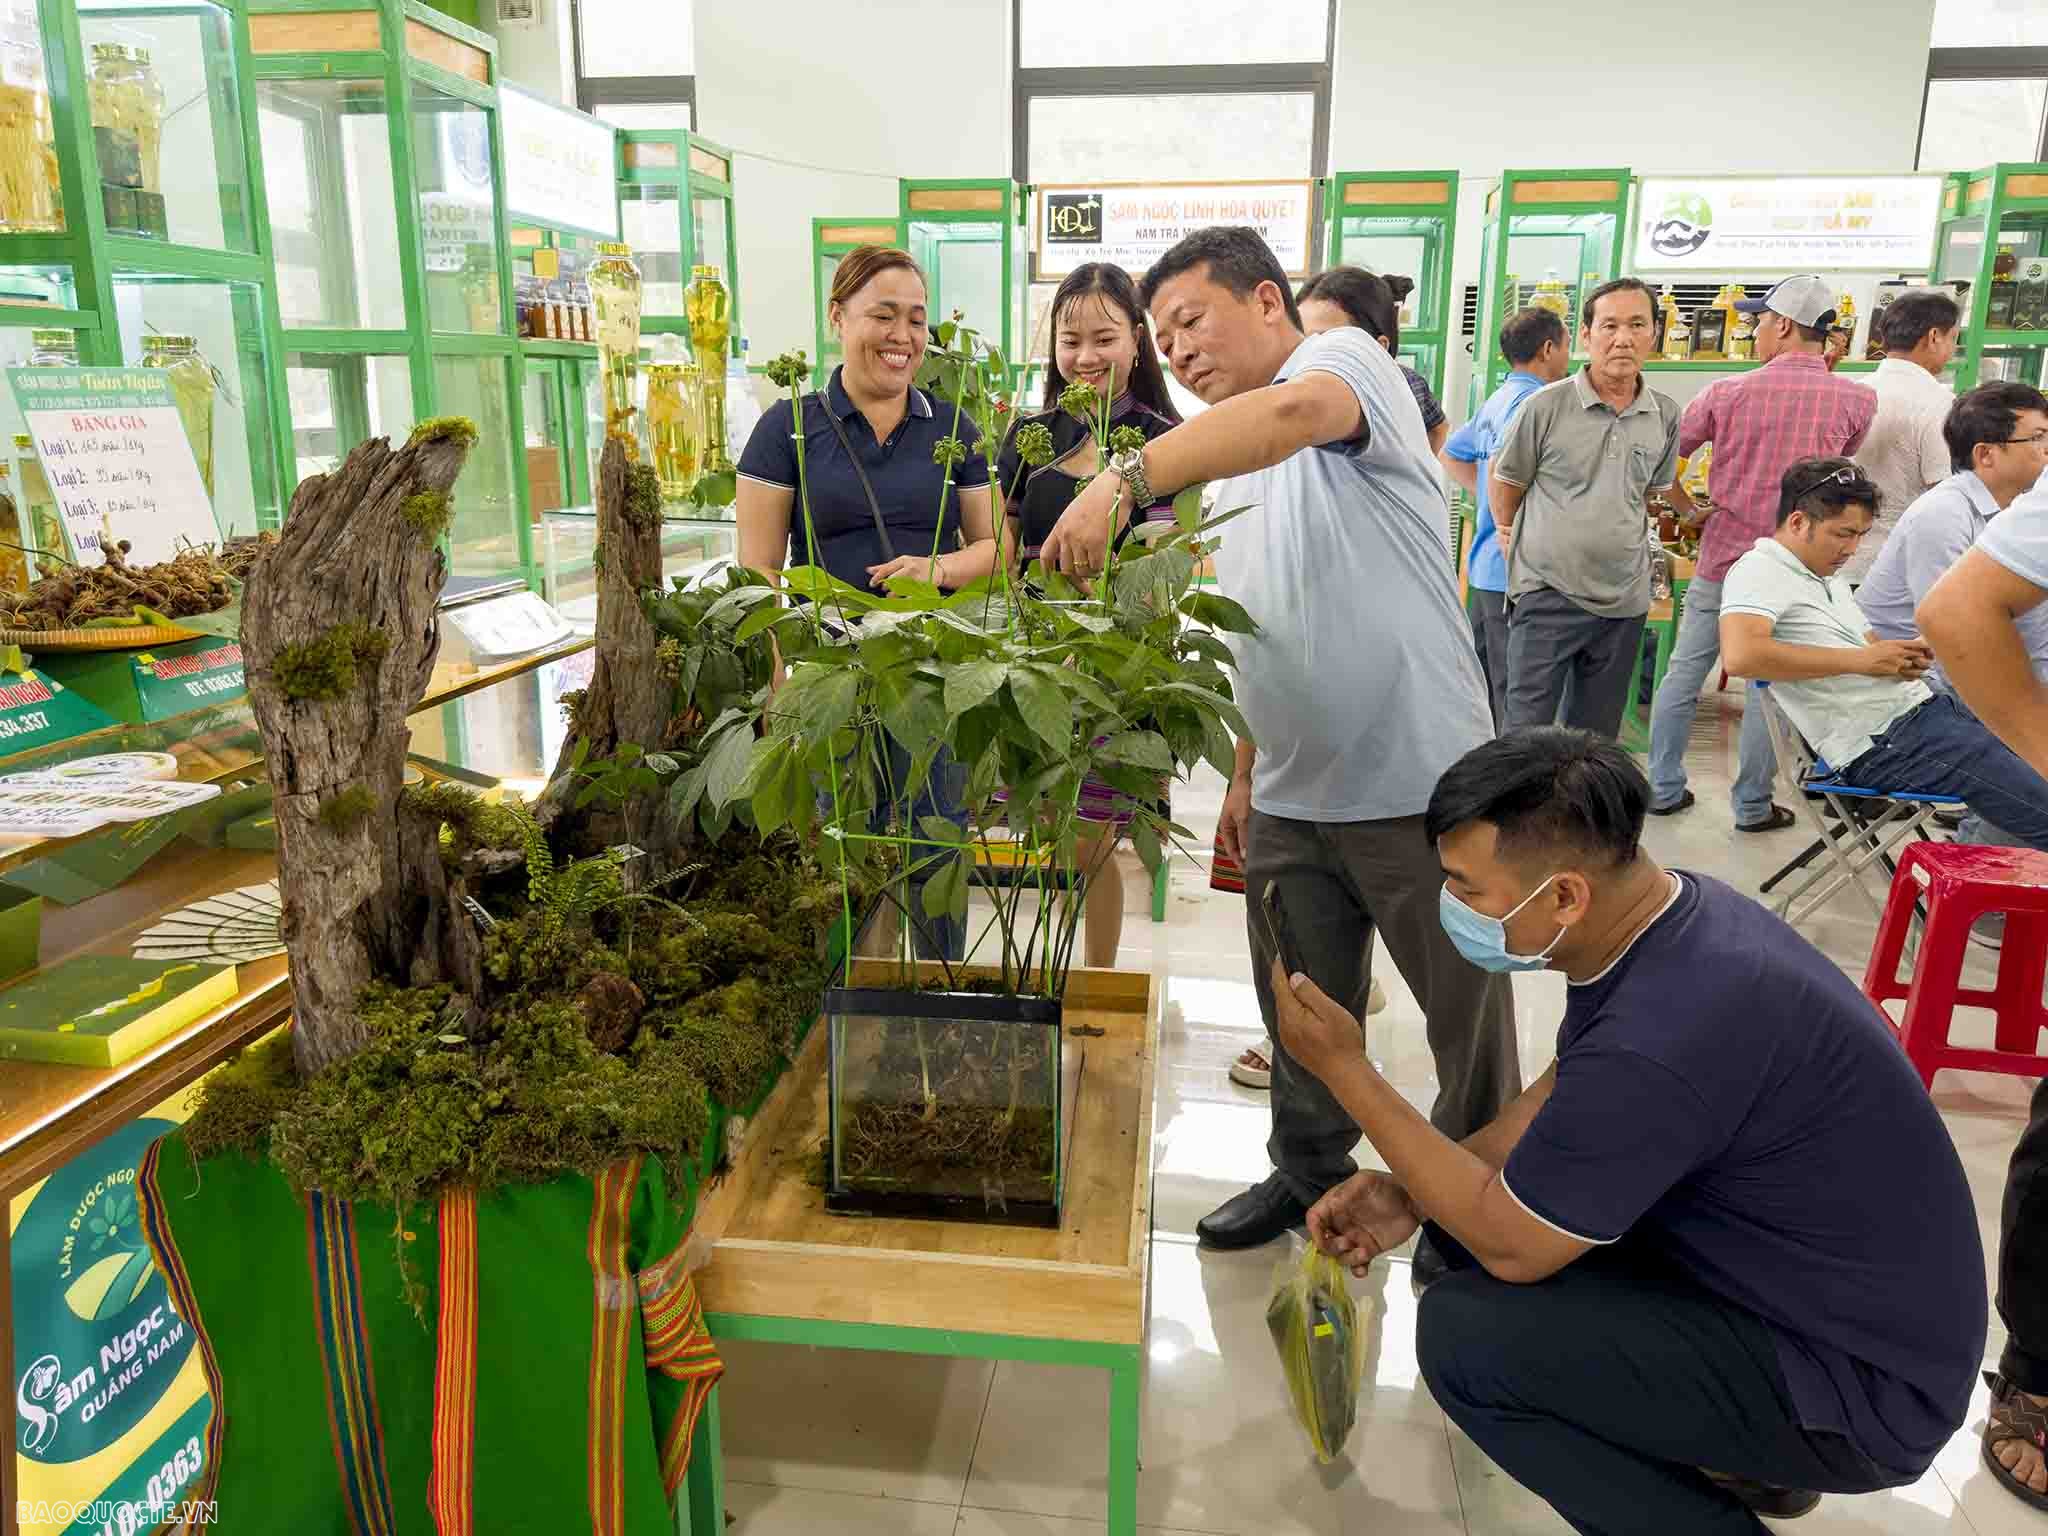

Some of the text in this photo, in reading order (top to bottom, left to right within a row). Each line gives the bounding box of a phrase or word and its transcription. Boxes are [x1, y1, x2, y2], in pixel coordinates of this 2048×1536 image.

[41, 439, 65, 459] Loại
[52, 468, 77, 488] Loại
[64, 499, 88, 521] Loại
[74, 530, 98, 553] Loại
[100, 1305, 165, 1375] Ngọc
[146, 1322, 184, 1365] NAM
